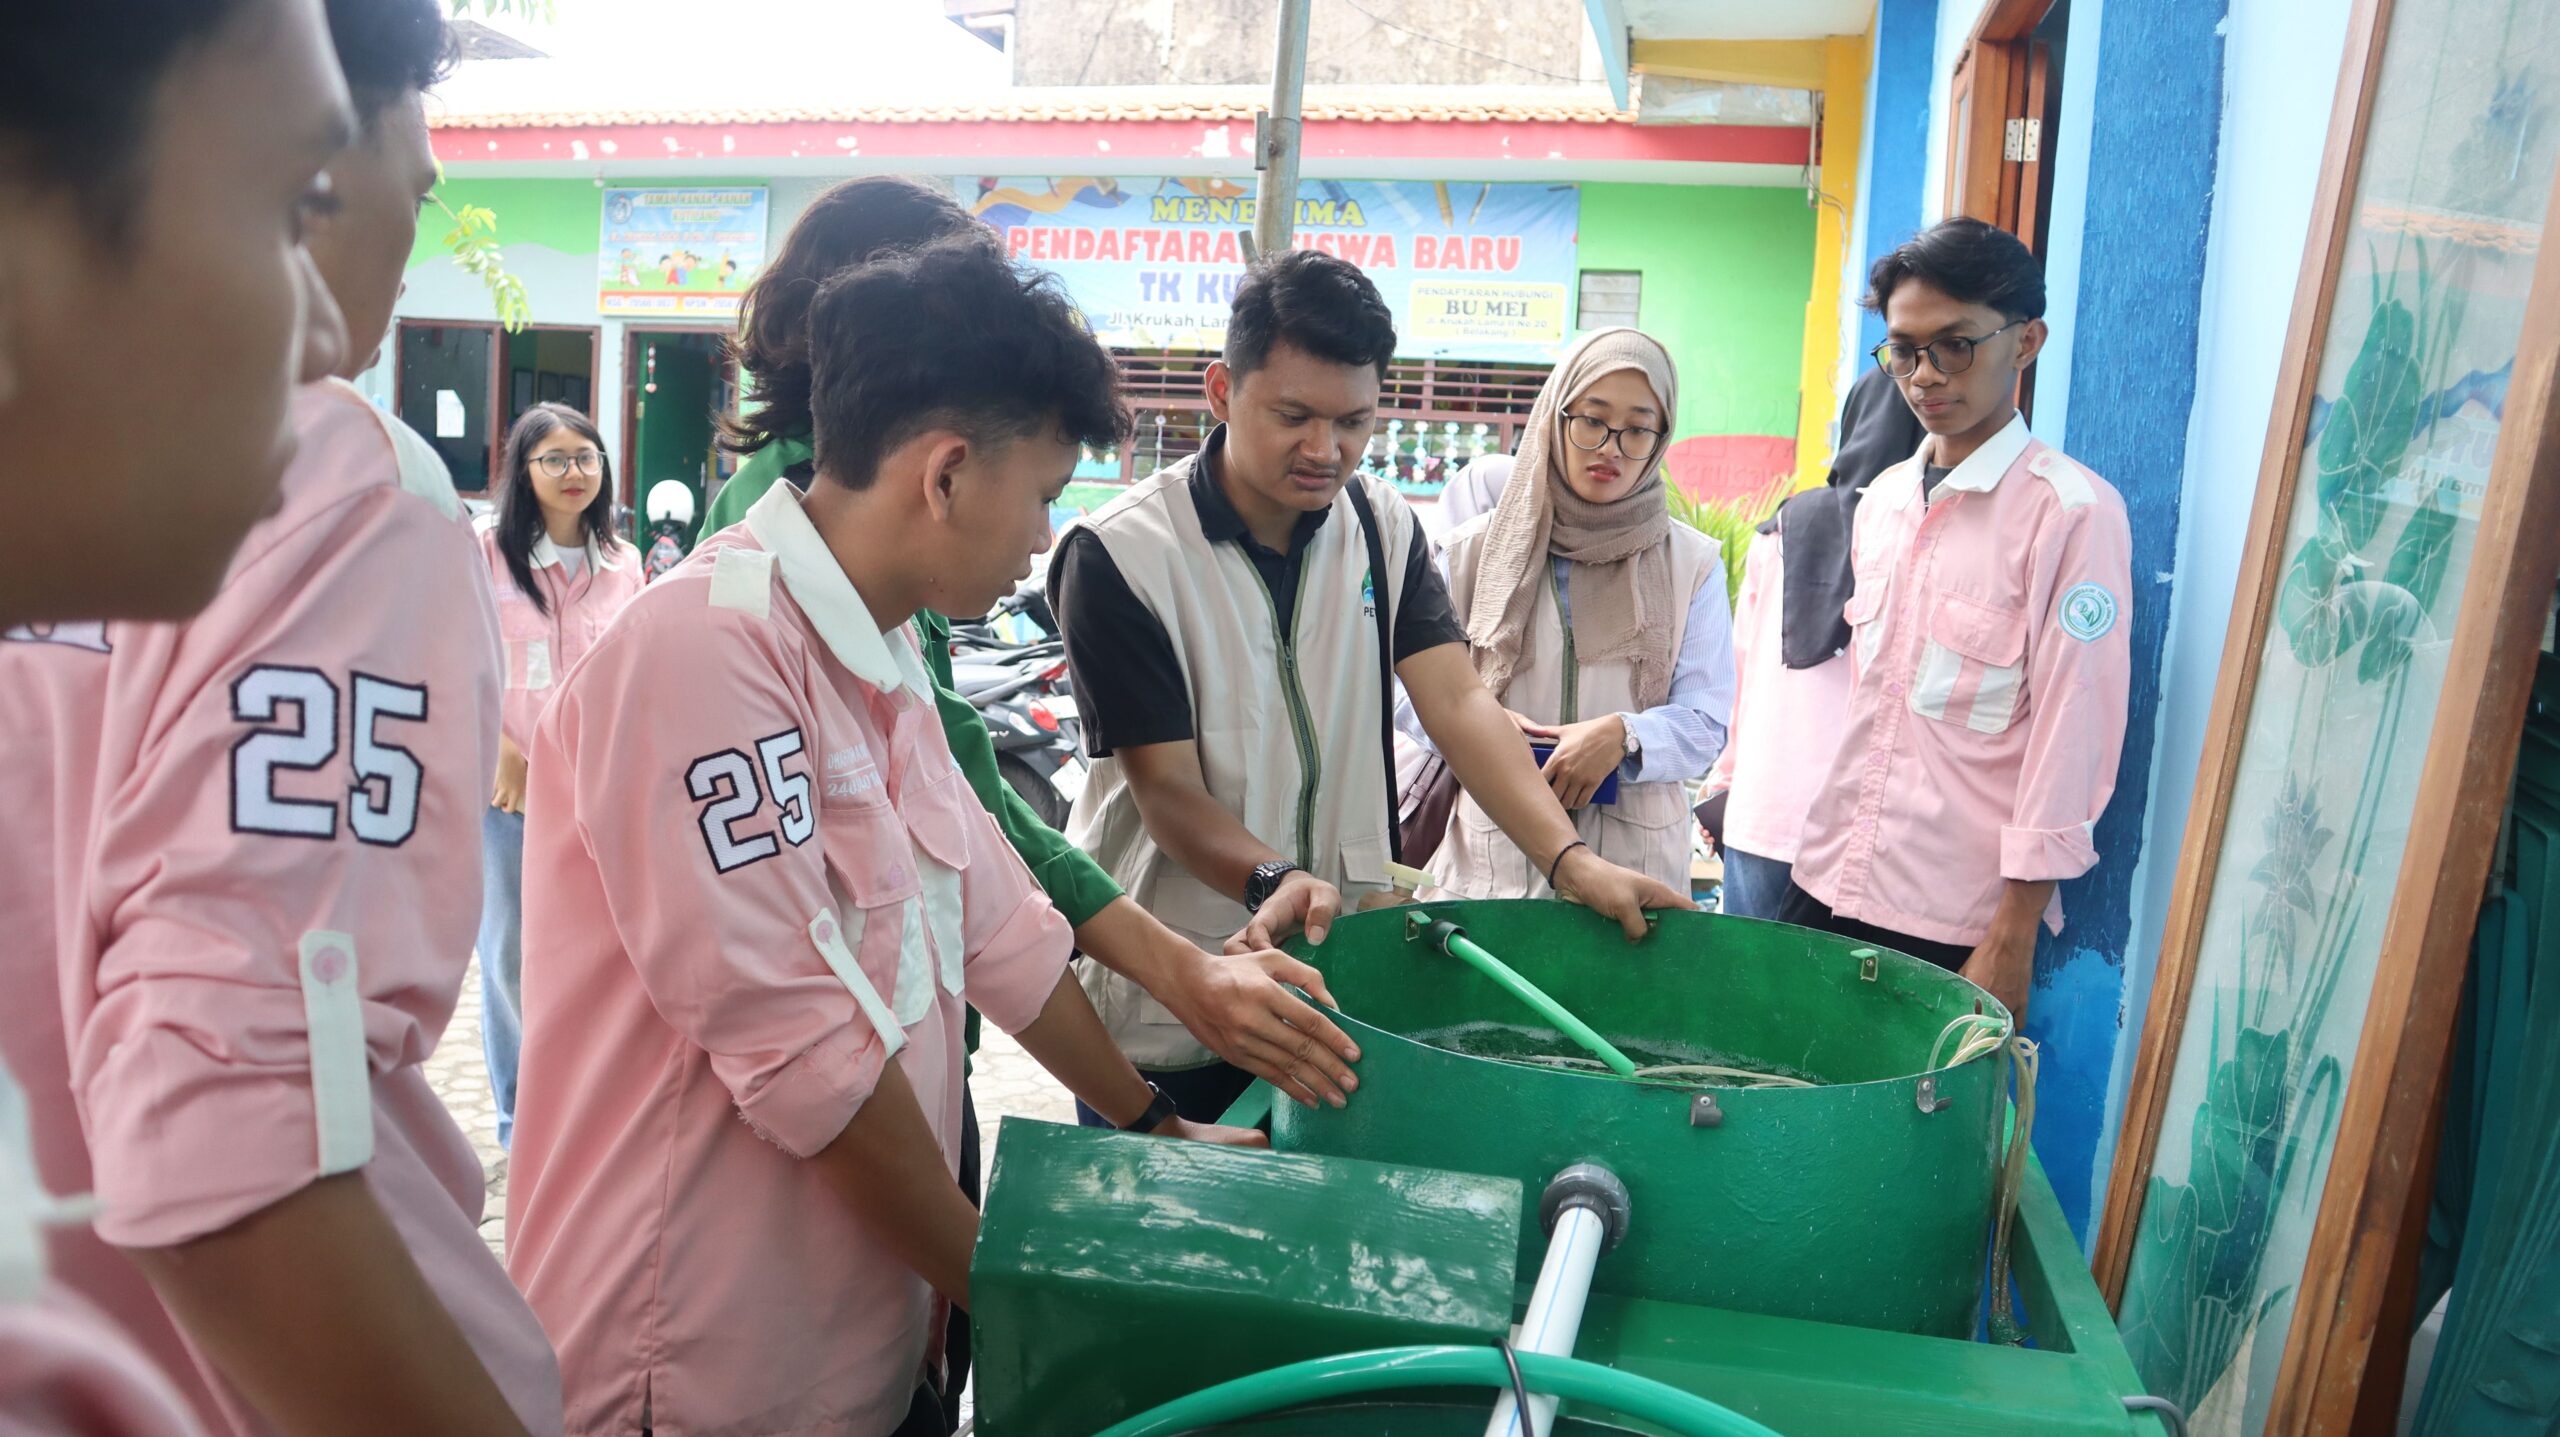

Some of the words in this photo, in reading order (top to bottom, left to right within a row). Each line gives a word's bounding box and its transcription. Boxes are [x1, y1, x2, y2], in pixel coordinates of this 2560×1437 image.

[1151, 196, 1367, 227] MENEIMA
[1007, 226, 1247, 264] PENDAFTARA
[1412, 234, 1522, 272] BARU
[1139, 271, 1181, 303] TK
[1417, 286, 1499, 297] PENDAFTARAN
[1133, 312, 1194, 327] Krukah
[1445, 299, 1478, 315] BU
[1485, 301, 1528, 317] MEI
[230, 663, 429, 849] 25
[684, 726, 815, 875] 25
